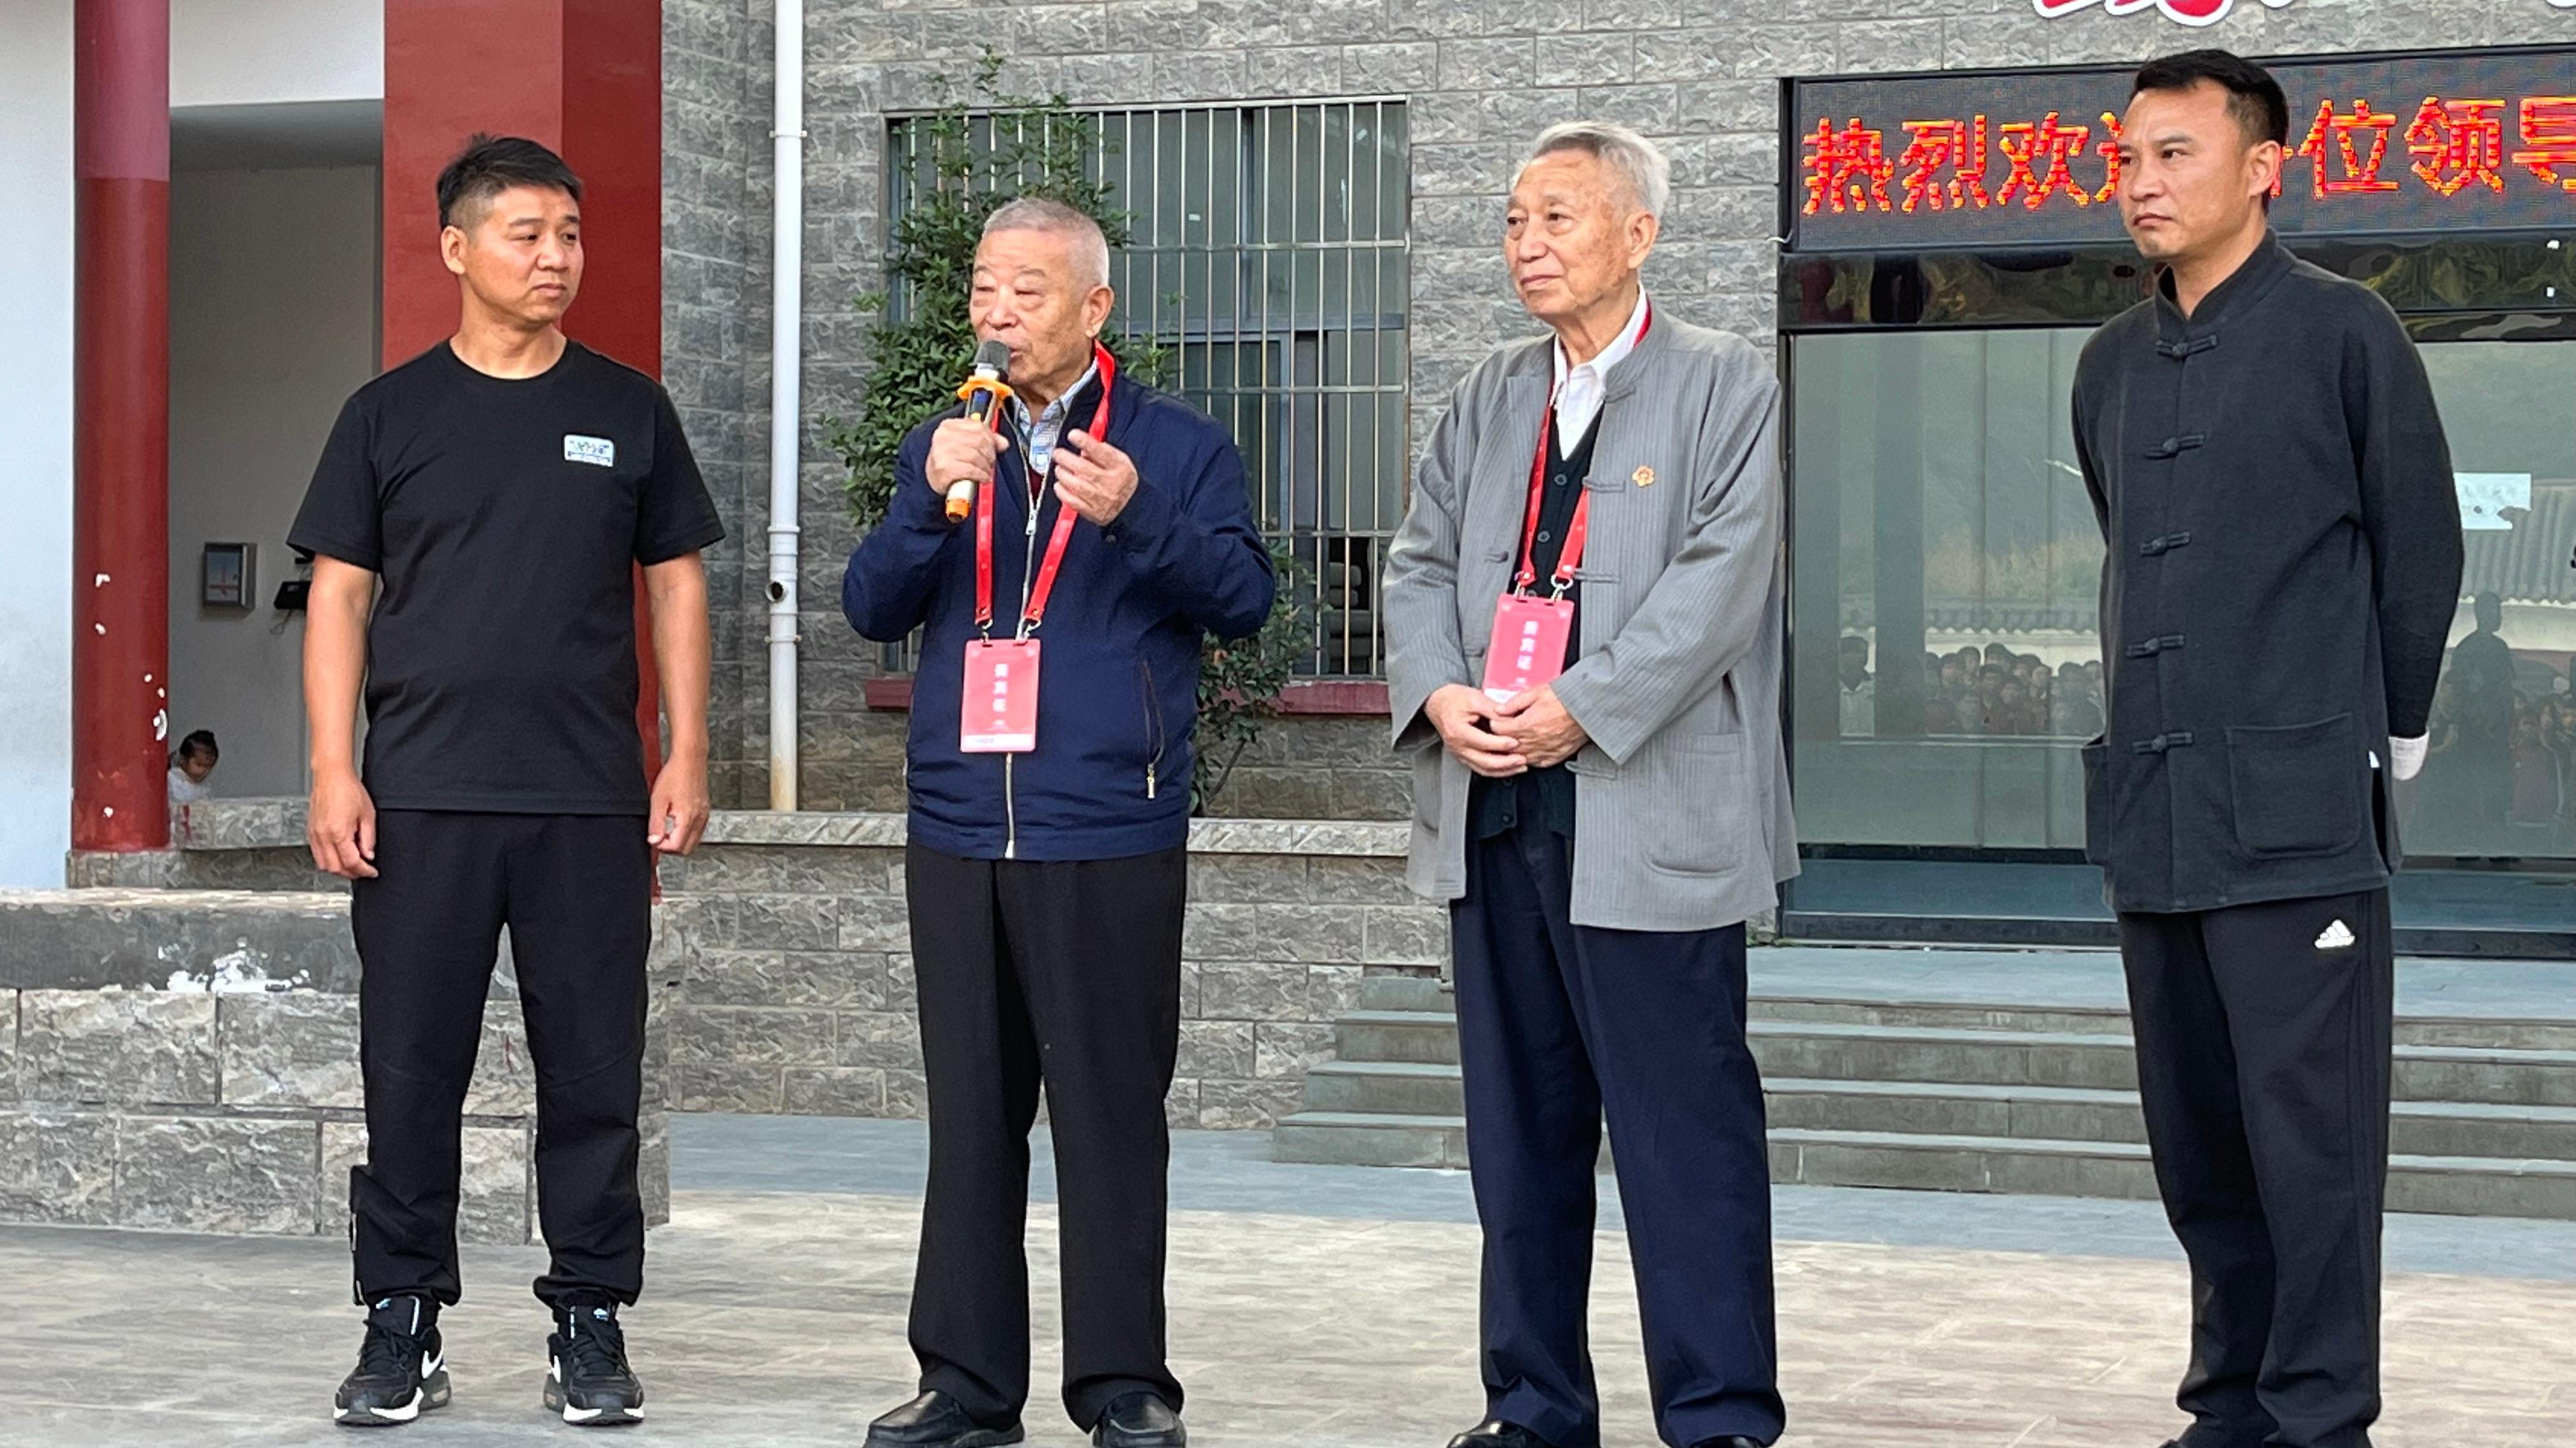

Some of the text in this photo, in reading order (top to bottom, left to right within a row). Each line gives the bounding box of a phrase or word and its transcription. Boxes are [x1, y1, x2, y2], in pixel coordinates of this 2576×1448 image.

[1803, 96, 2576, 215] 热烈欢位领导
